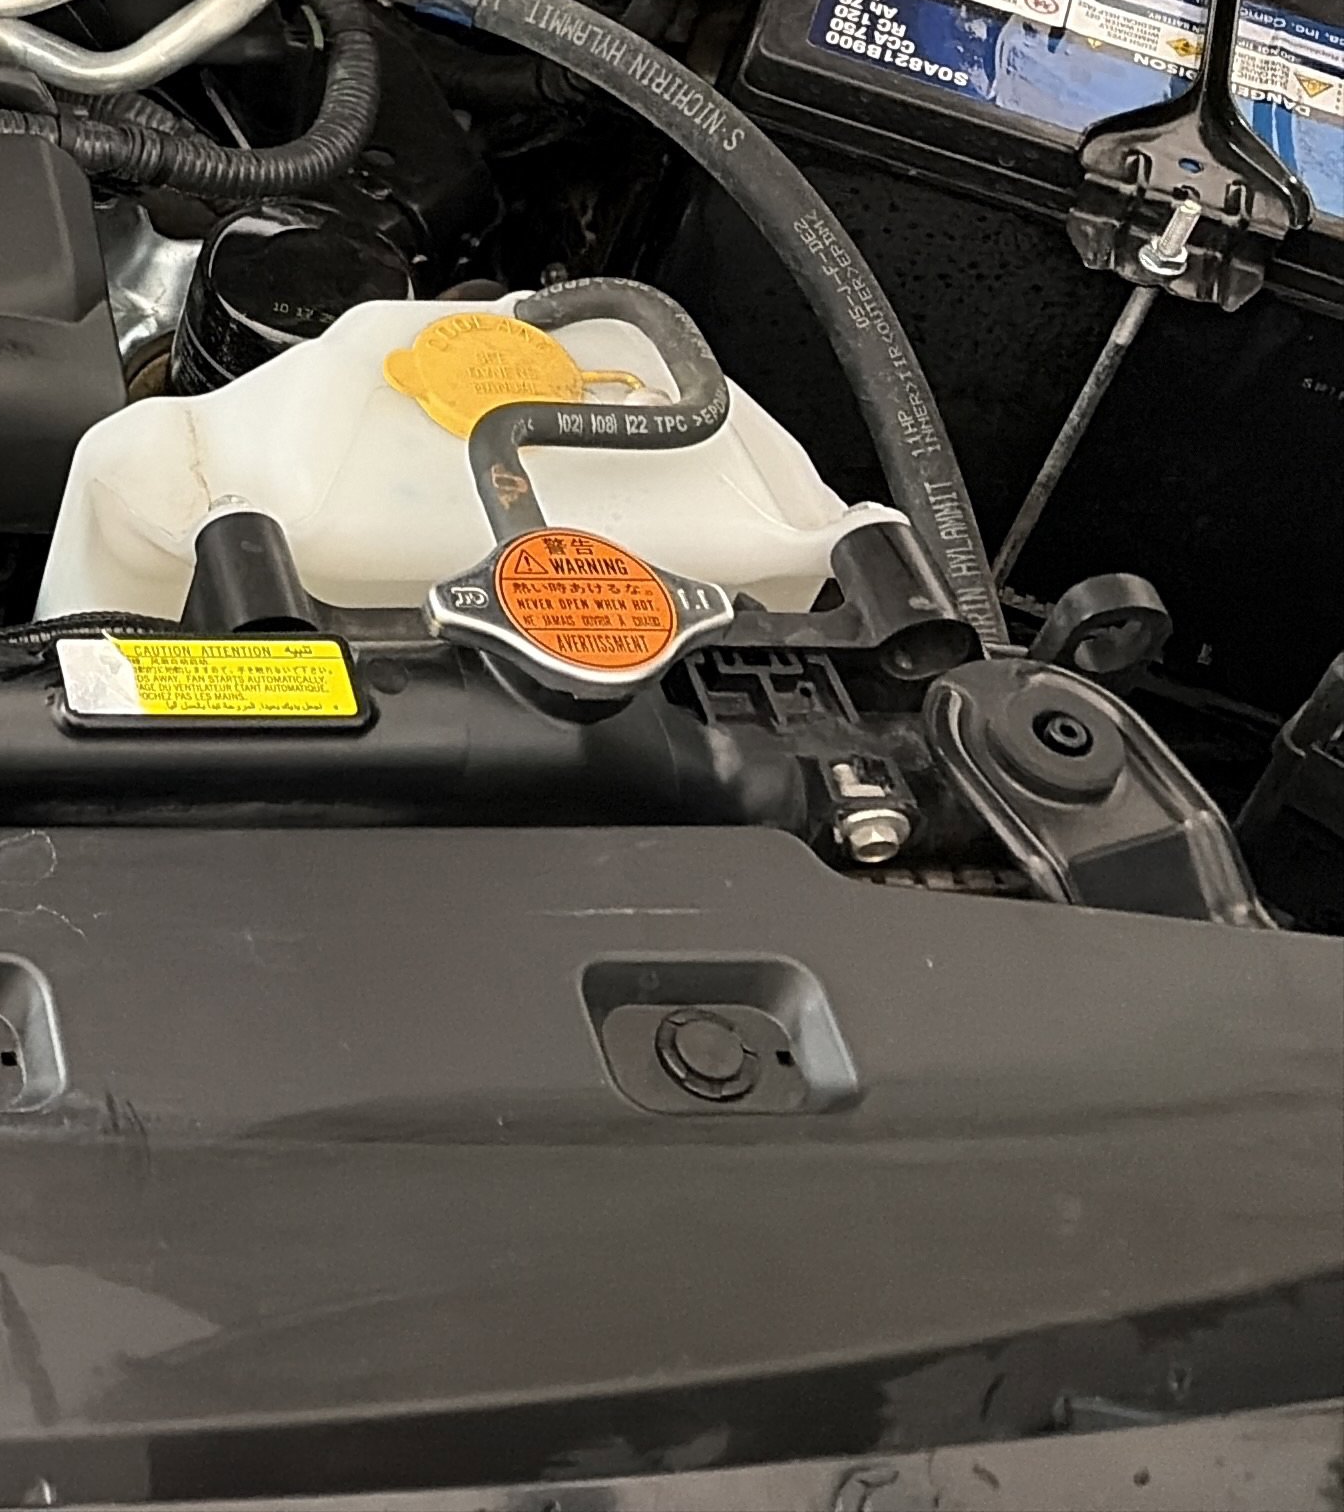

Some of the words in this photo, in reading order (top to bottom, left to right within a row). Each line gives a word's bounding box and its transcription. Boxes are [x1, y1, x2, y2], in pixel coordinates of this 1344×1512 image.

[832, 3, 873, 26] 120
[867, 0, 898, 20] Ah
[828, 15, 869, 39] 750
[875, 16, 907, 37] RC
[870, 29, 916, 55] CCA
[1233, 84, 1311, 118] DANGE
[273, 301, 288, 313] 10
[656, 416, 687, 433] TPC
[923, 477, 981, 578] HYLAMMIT
[542, 538, 594, 556] 警告
[549, 558, 628, 575] WARNING
[518, 599, 551, 610] NEVER
[559, 599, 589, 610] OPEN
[594, 599, 627, 610] WHEN
[633, 600, 660, 611] HOT.
[134, 646, 191, 656] CAUTION
[201, 646, 271, 657] ATTENTION
[209, 676, 245, 684] STARTS
[248, 676, 328, 684] AUTOMATICALLY.
